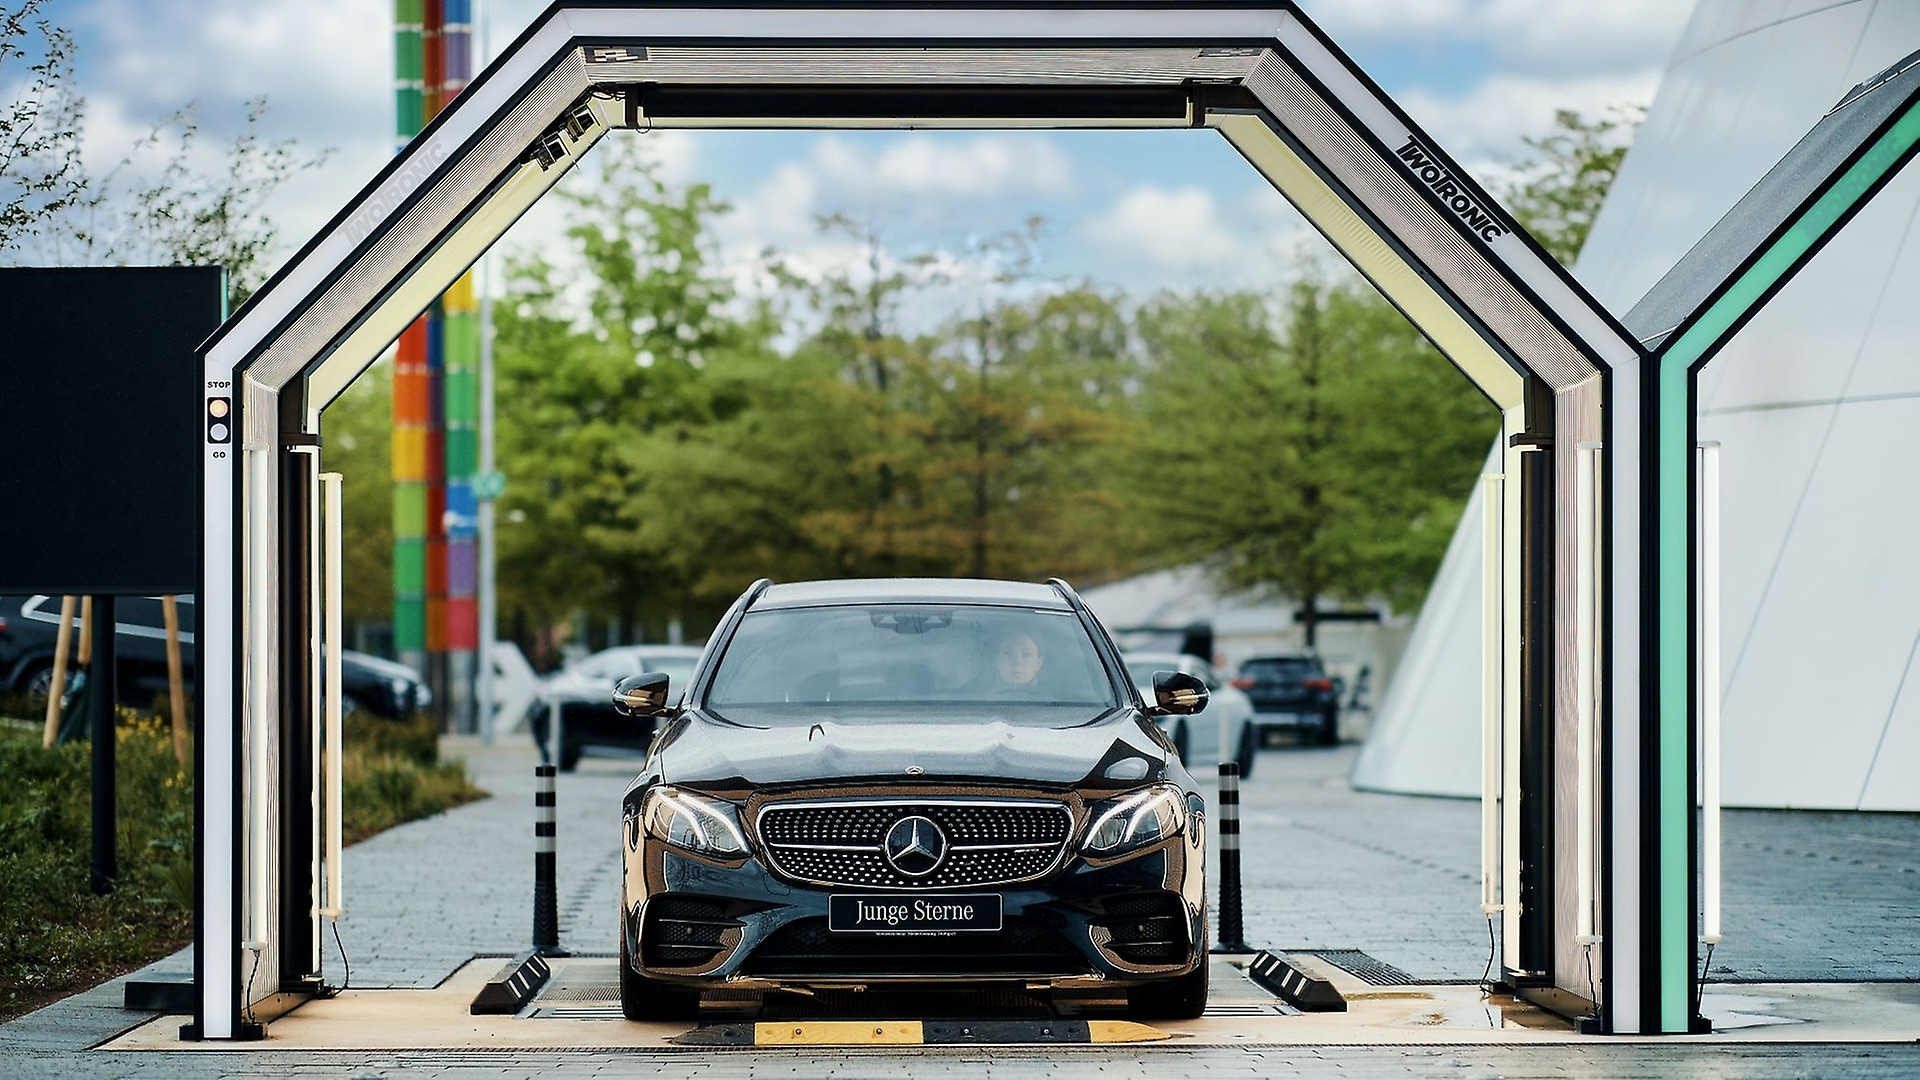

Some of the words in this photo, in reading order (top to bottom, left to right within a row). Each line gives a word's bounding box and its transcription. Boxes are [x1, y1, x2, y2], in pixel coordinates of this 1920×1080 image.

[1396, 134, 1511, 243] TWOTRONIC
[855, 900, 909, 925] Junge
[913, 899, 974, 921] Sterne
